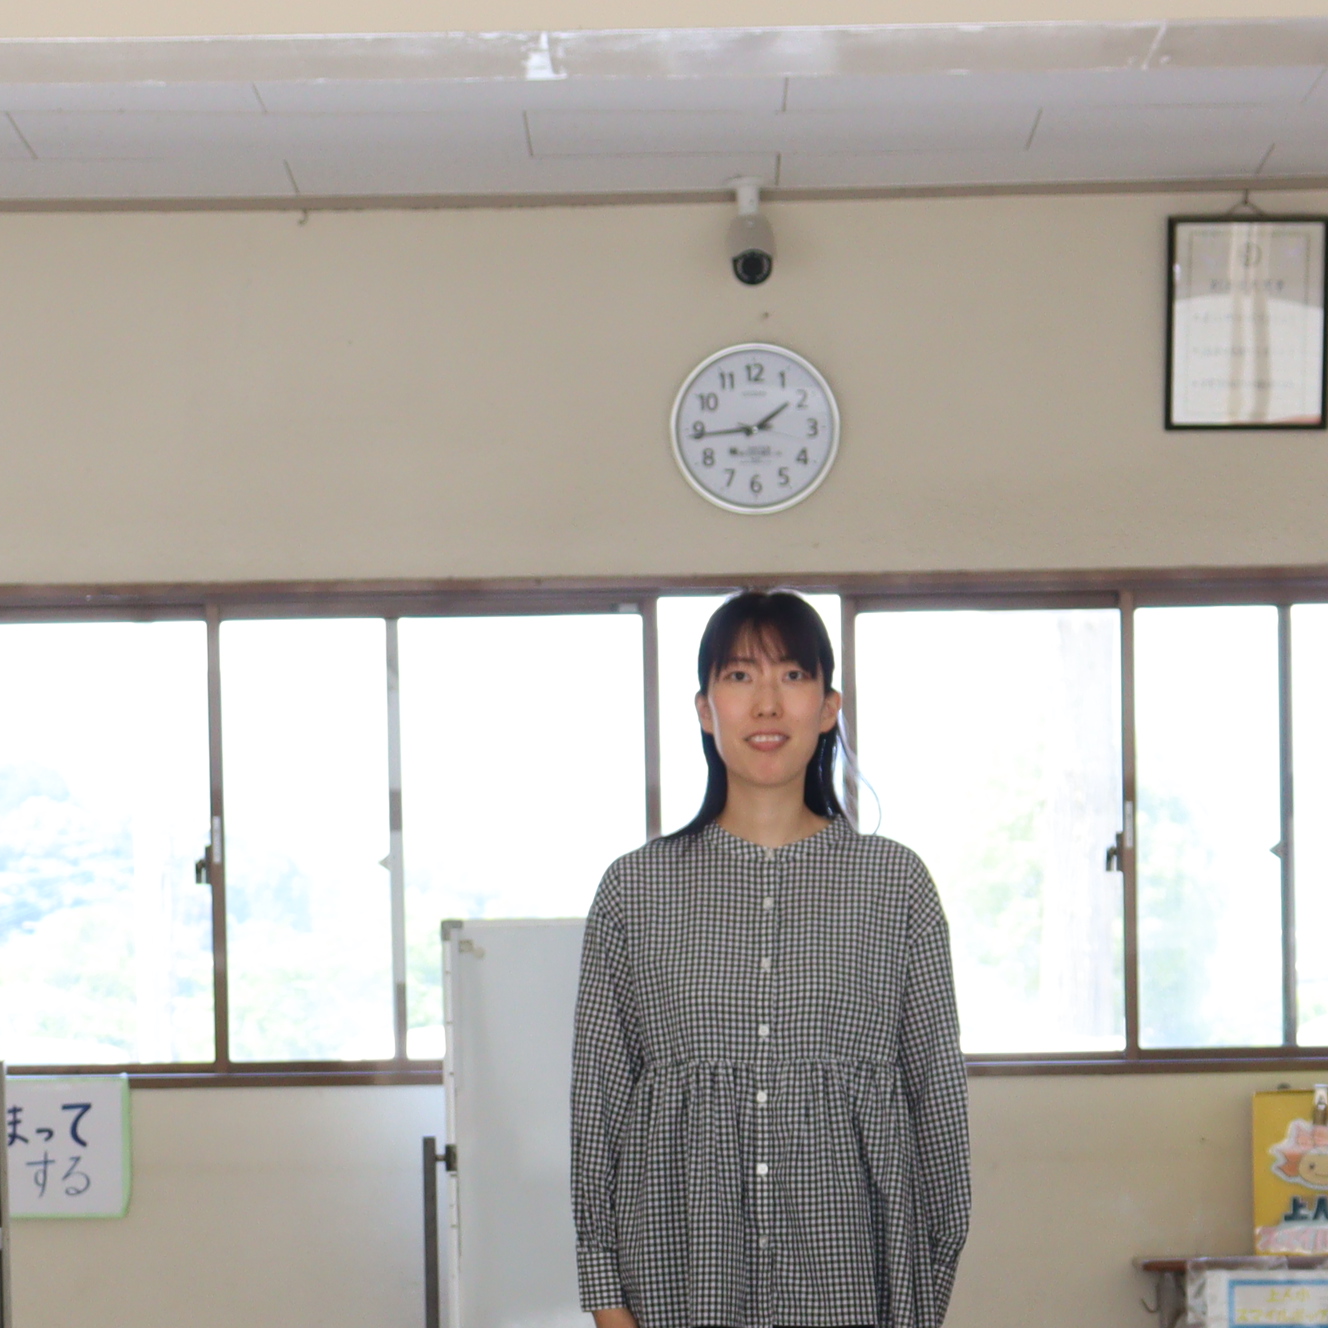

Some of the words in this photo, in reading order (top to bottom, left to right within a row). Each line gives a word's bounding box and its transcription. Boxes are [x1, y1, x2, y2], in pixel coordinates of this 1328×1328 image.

[720, 371, 735, 390] 11
[746, 364, 765, 382] 12
[779, 371, 786, 388] 1
[698, 393, 718, 411] 10
[796, 389, 809, 408] 2
[693, 421, 705, 440] 9
[806, 418, 819, 437] 3
[702, 448, 715, 467] 8
[796, 448, 808, 465] 4
[724, 468, 735, 487] 7
[750, 474, 762, 493] 6
[778, 467, 790, 486] 5
[7, 1102, 92, 1148] まって
[26, 1150, 91, 1198] する
[1266, 1288, 1311, 1303] 上人小
